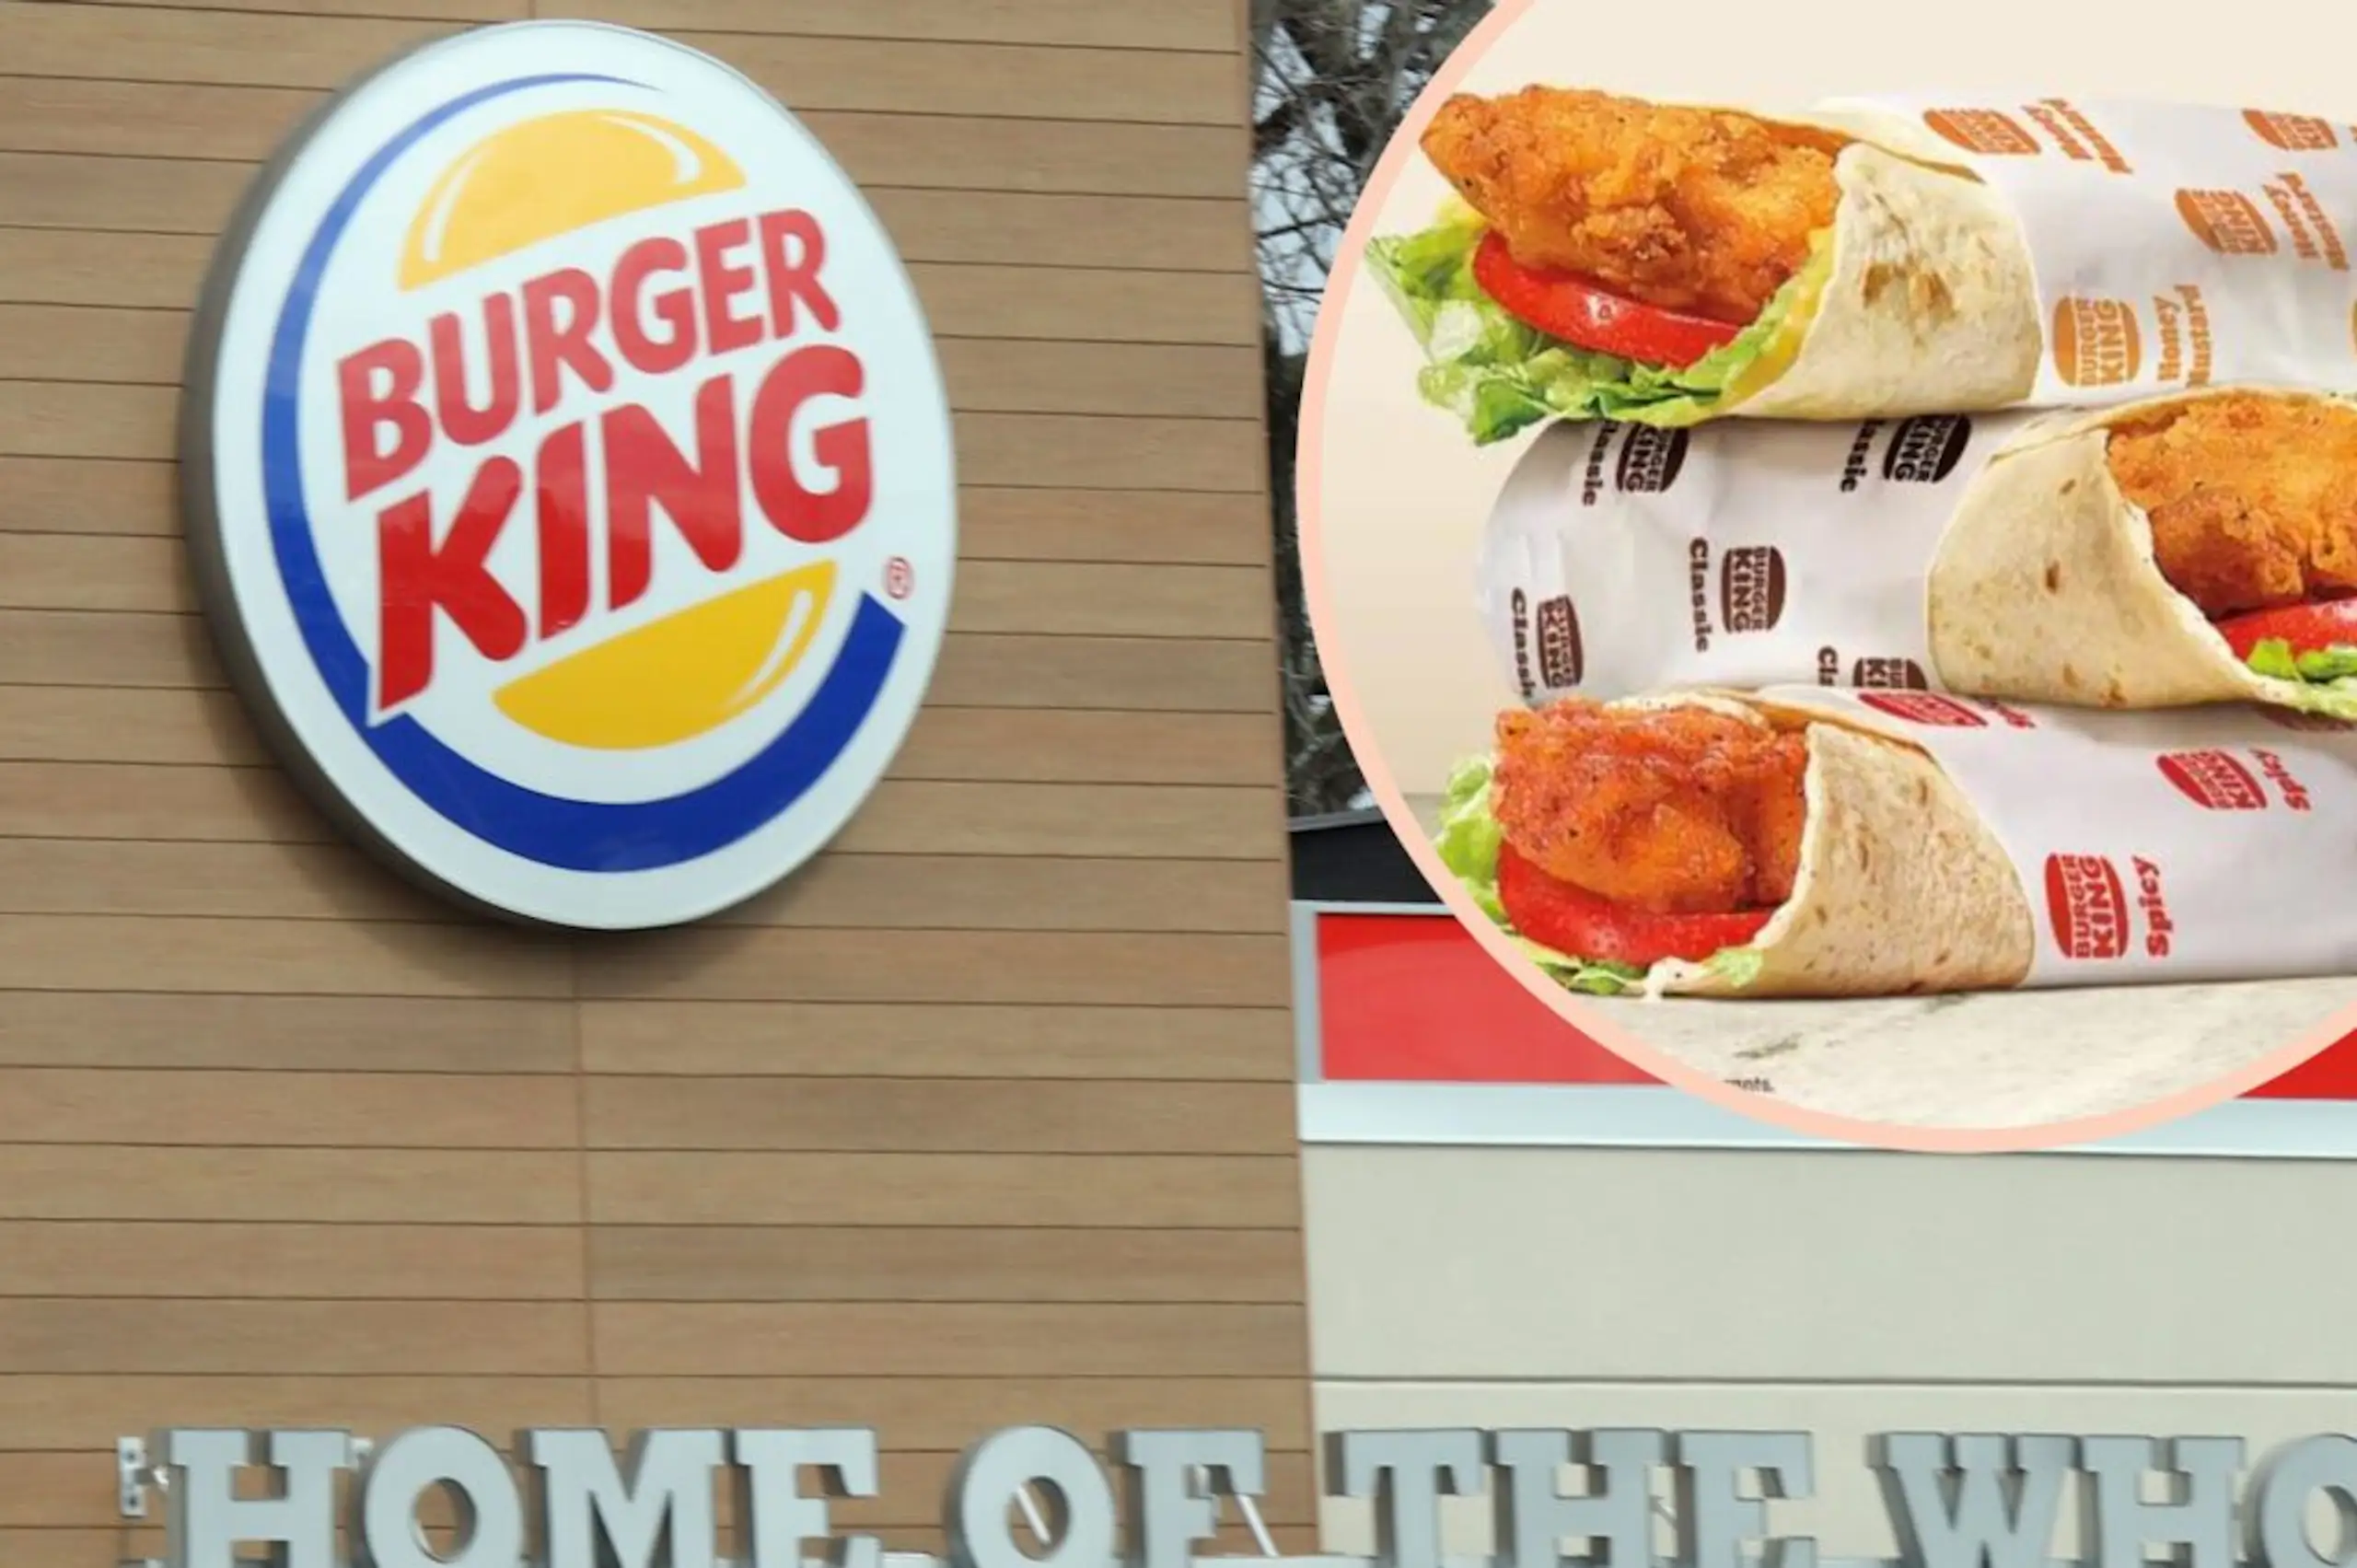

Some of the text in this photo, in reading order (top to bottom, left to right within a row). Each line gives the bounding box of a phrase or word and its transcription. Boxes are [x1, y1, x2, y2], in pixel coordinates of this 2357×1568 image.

[334, 207, 839, 504] BURGER
[377, 343, 872, 712] KING
[1689, 538, 1713, 652] Classic
[1733, 547, 1751, 633] KING
[2078, 855, 2115, 958] KING
[2131, 854, 2173, 958] Spicy
[158, 1426, 876, 1568] HOME
[953, 1424, 1264, 1568] OF
[1326, 1429, 1812, 1568] THE
